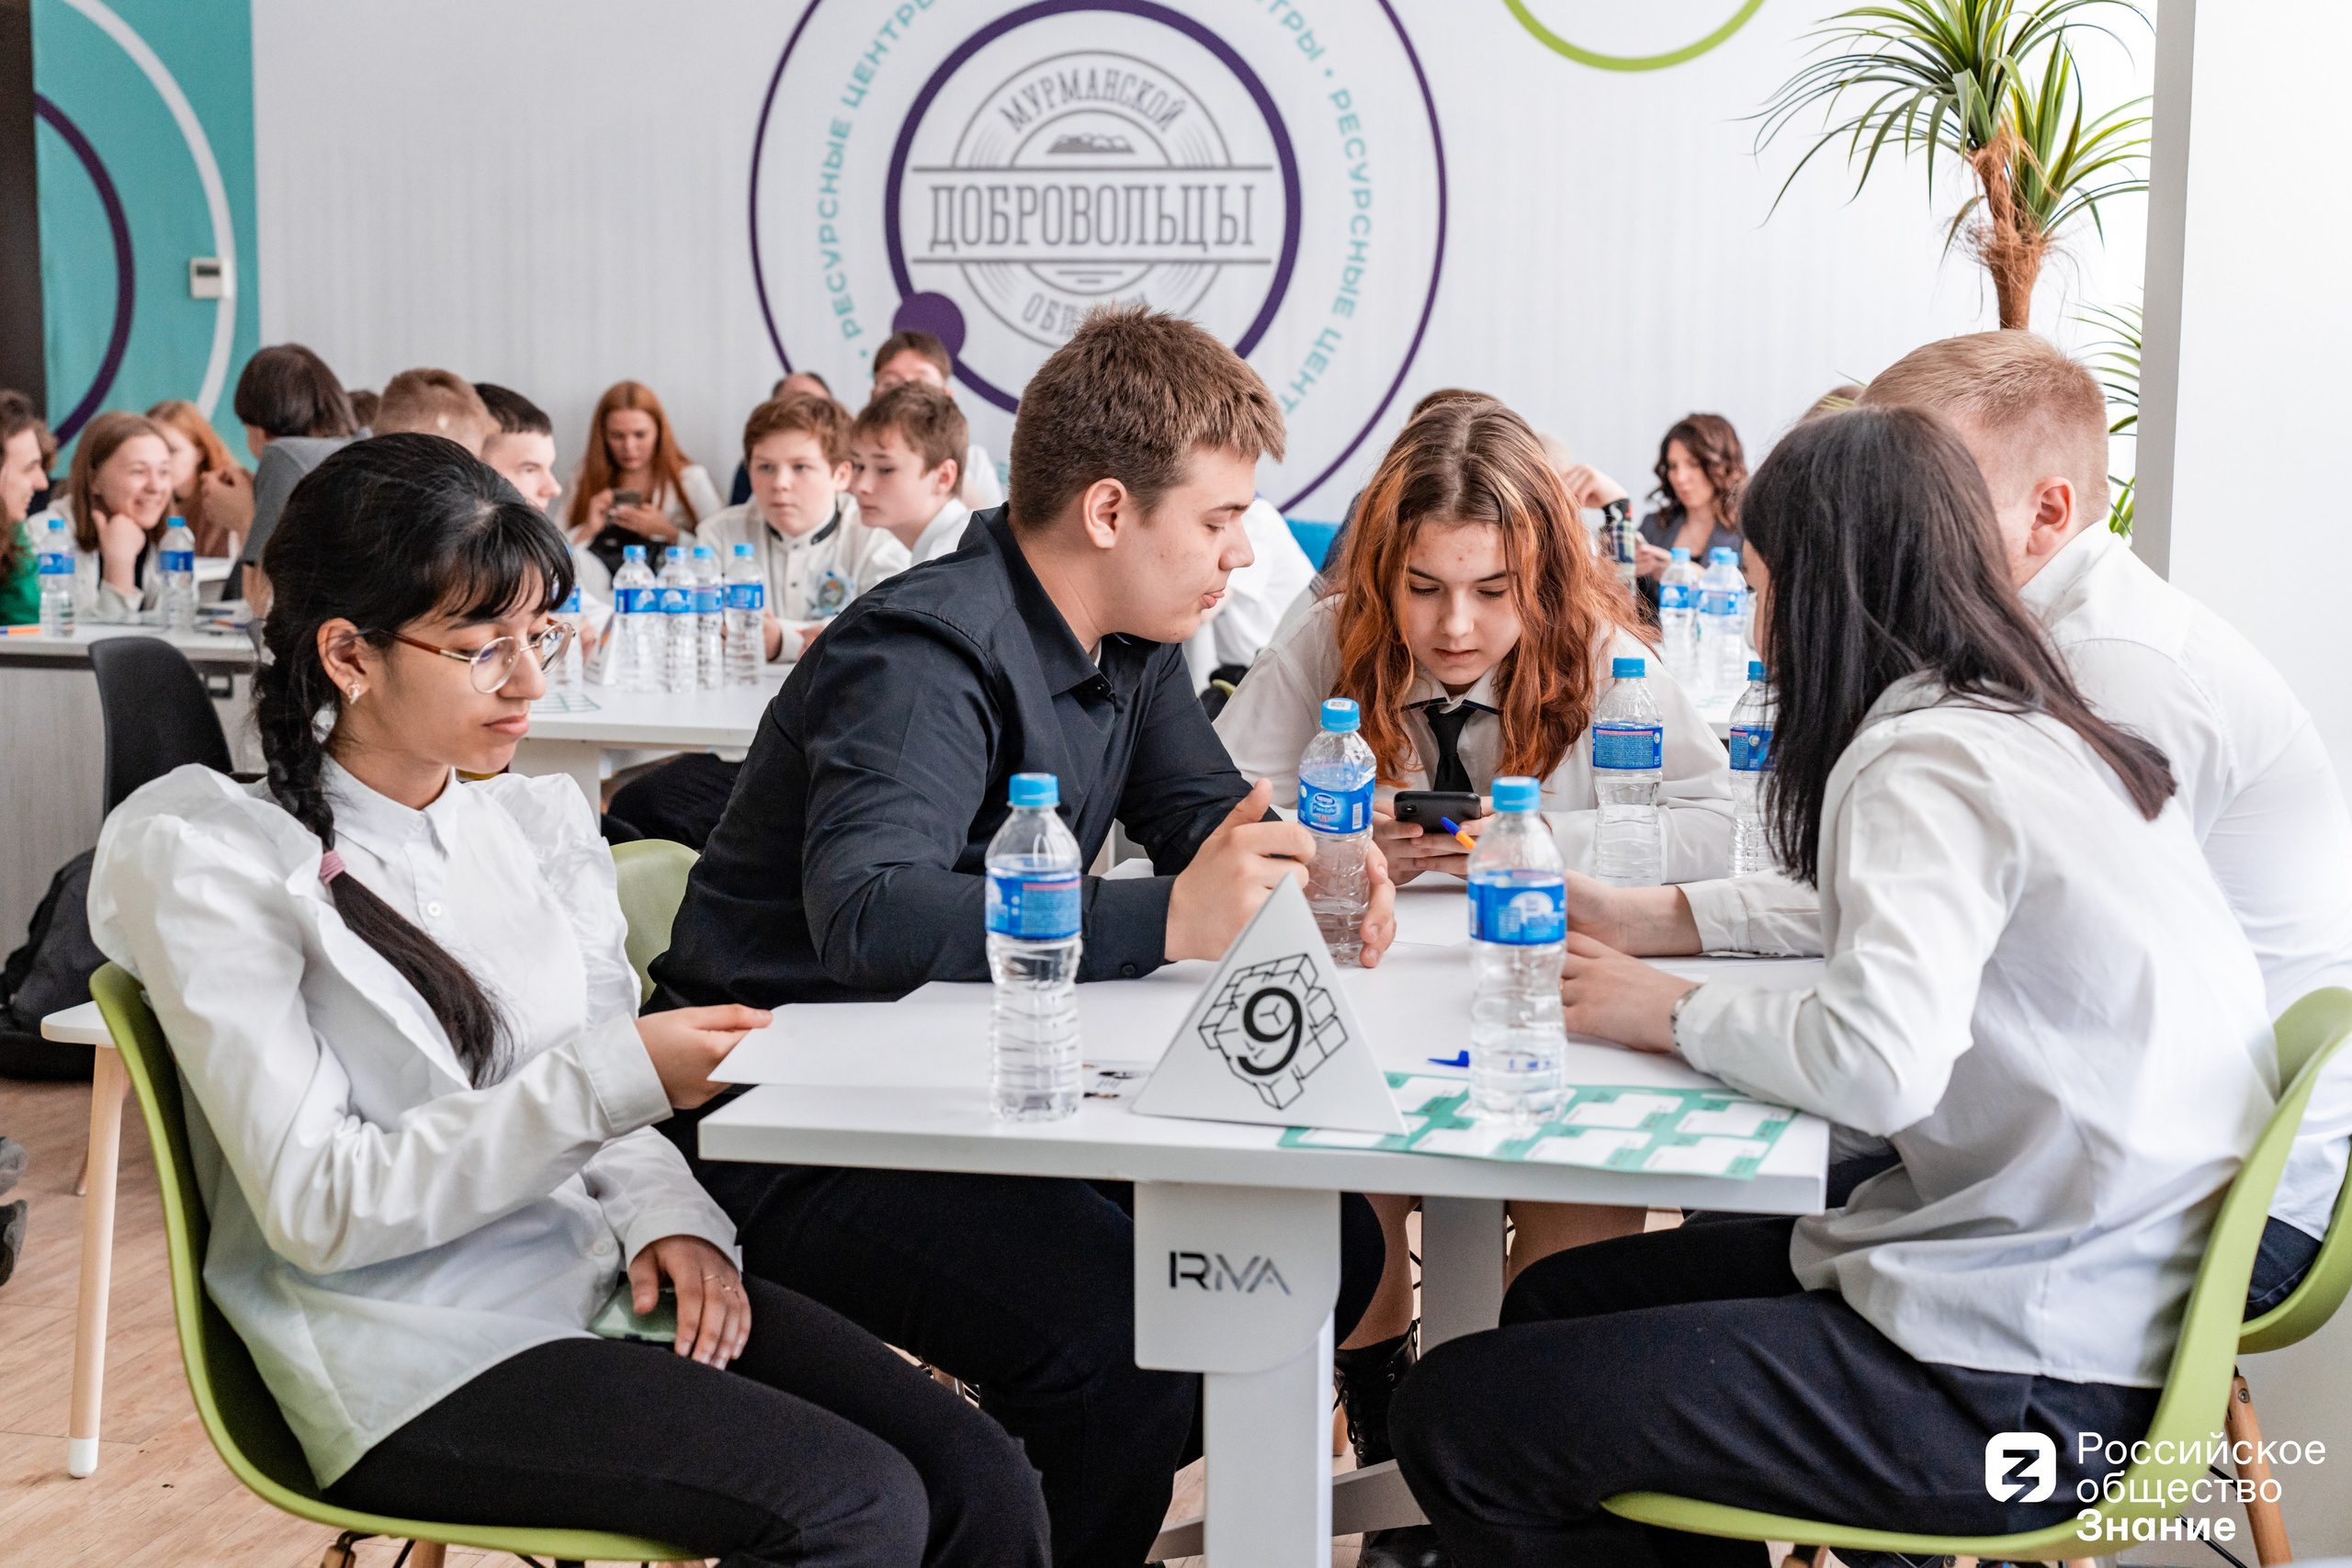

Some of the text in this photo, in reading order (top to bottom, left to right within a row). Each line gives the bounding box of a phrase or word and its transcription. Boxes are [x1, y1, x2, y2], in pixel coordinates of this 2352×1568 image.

[999, 67, 1186, 133] МУРМАНСКОЙ
[818, 118, 862, 340] РЕСУРСНЫЕ
[928, 184, 1255, 254] ДОБРОВОЛЬЦЫ
[1329, 88, 1371, 319] РЕСУРСНЫЕ
[1280, 327, 1342, 415] ЦЕНТ
[1237, 987, 1303, 1077] 9
